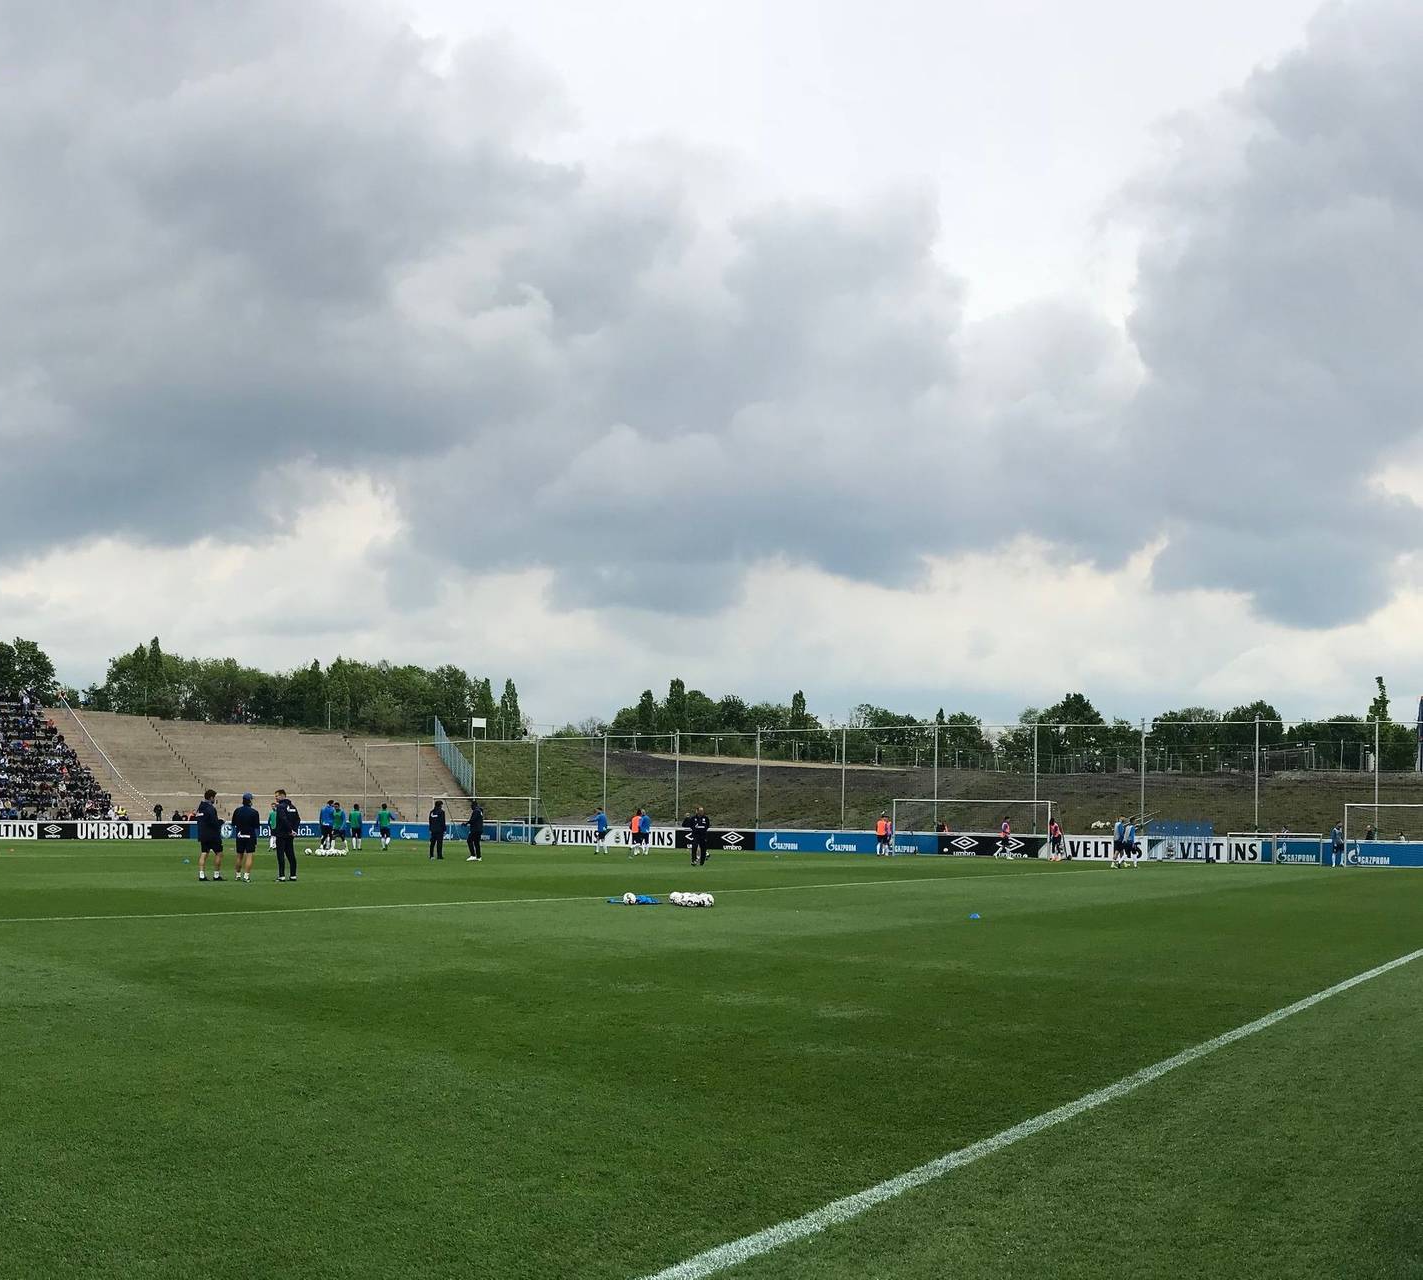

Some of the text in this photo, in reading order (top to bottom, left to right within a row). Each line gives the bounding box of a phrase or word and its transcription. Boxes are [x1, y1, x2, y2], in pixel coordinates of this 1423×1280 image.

[76, 823, 152, 840] UMBRO.DE
[552, 829, 598, 844] VELTINS
[777, 842, 798, 851] GAZPROM
[833, 843, 856, 852] GAZPROM
[1287, 854, 1316, 862] GAZPROM
[1360, 856, 1390, 865] GAZPROM
